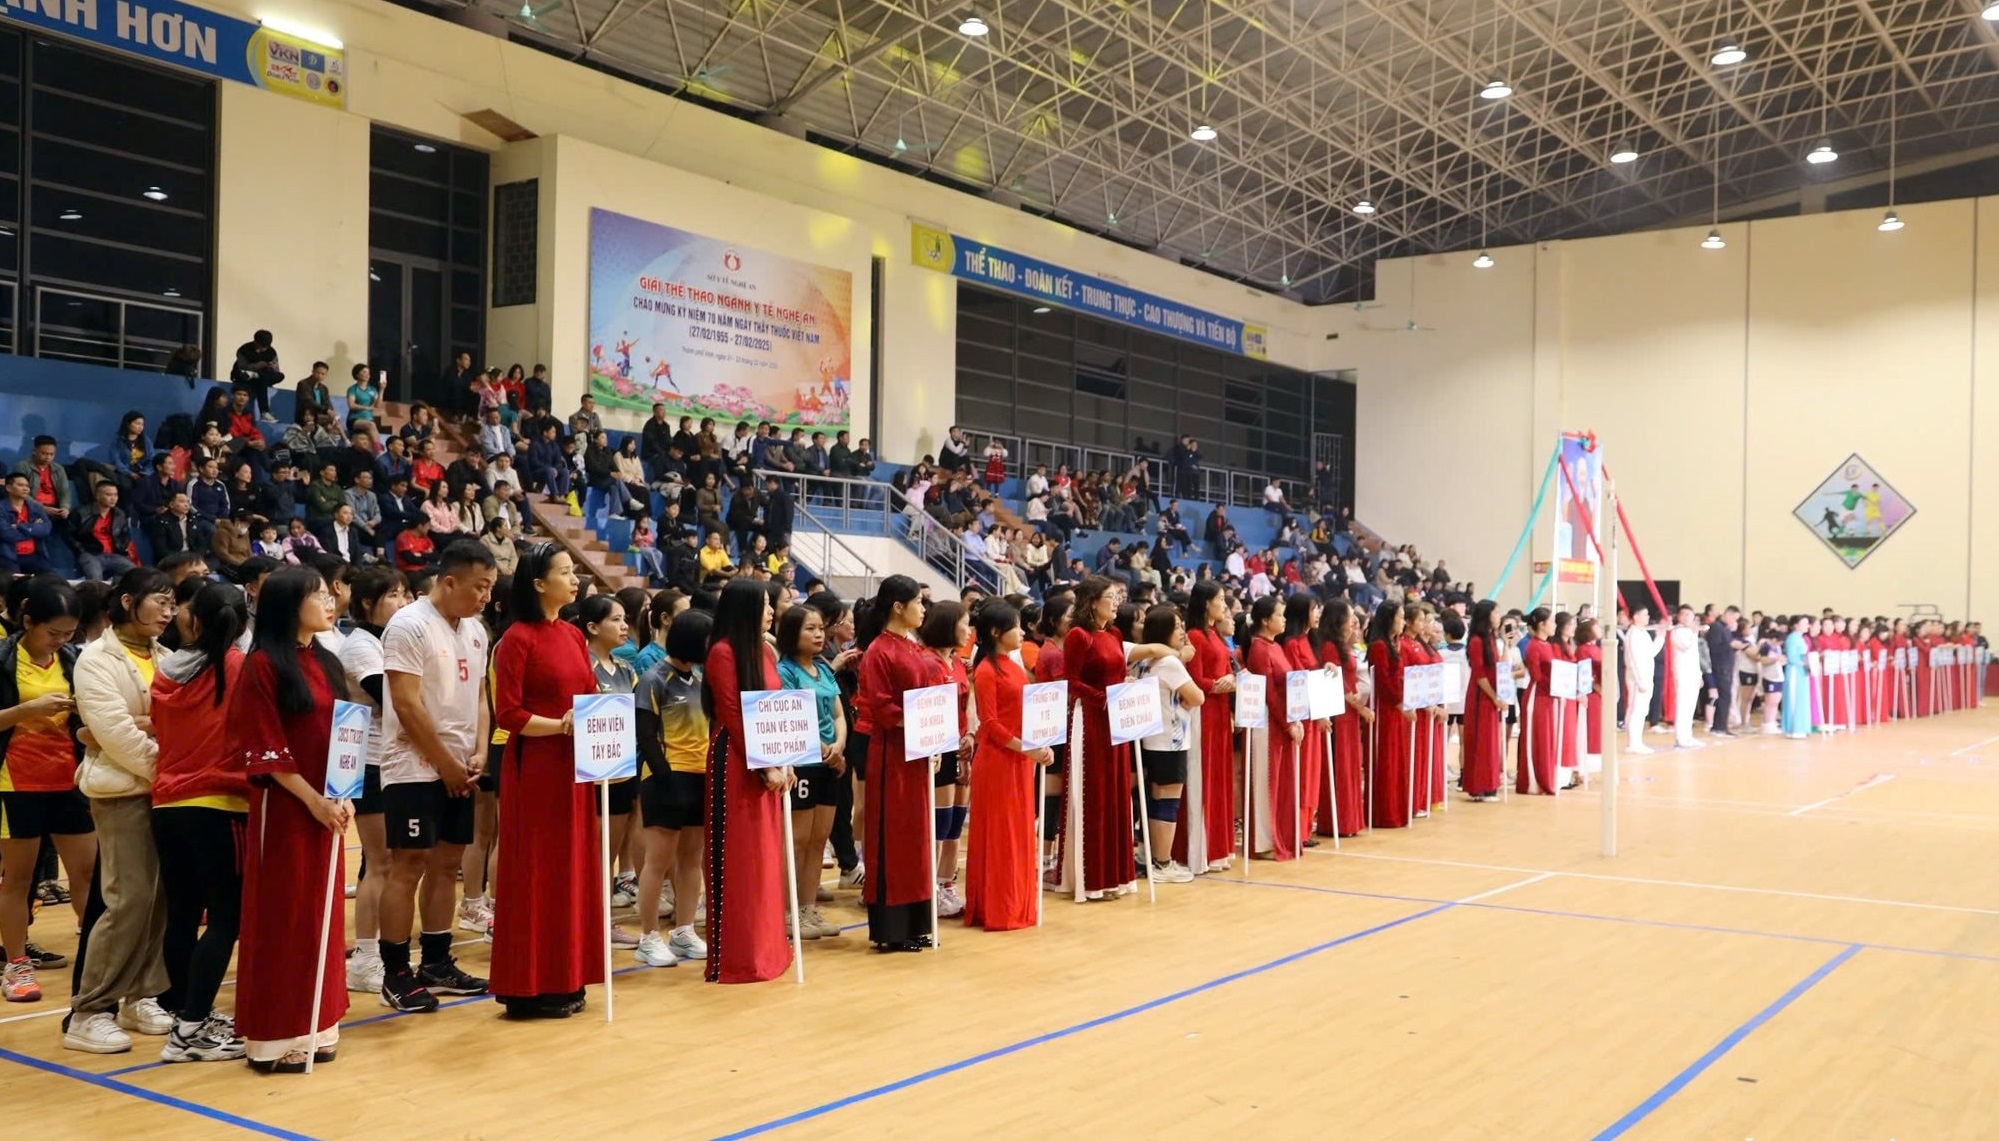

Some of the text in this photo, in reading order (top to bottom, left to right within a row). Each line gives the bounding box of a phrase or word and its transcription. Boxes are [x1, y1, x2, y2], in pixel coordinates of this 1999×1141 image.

[116, 2, 217, 65] HƠN
[965, 247, 986, 275] THỂ
[988, 257, 1016, 283] THAO
[1025, 268, 1053, 295] ĐOÀN
[1055, 273, 1073, 299] KẾT
[1082, 285, 1112, 311] TRUNG
[1114, 294, 1136, 320] THỰC
[1144, 303, 1161, 324] CAO
[687, 287, 714, 304] THAO
[754, 302, 759, 314] Y
[803, 313, 815, 325] AN
[708, 312, 716, 325] 70
[806, 333, 820, 344] NAM
[458, 658, 469, 682] 5
[758, 699, 802, 715] CHI CỤC AN
[587, 714, 624, 737] BỆNH VIỆN
[790, 720, 809, 732] SINH
[592, 738, 621, 760] TÂY BẮC
[798, 779, 809, 799] 6
[408, 818, 420, 837] 5
